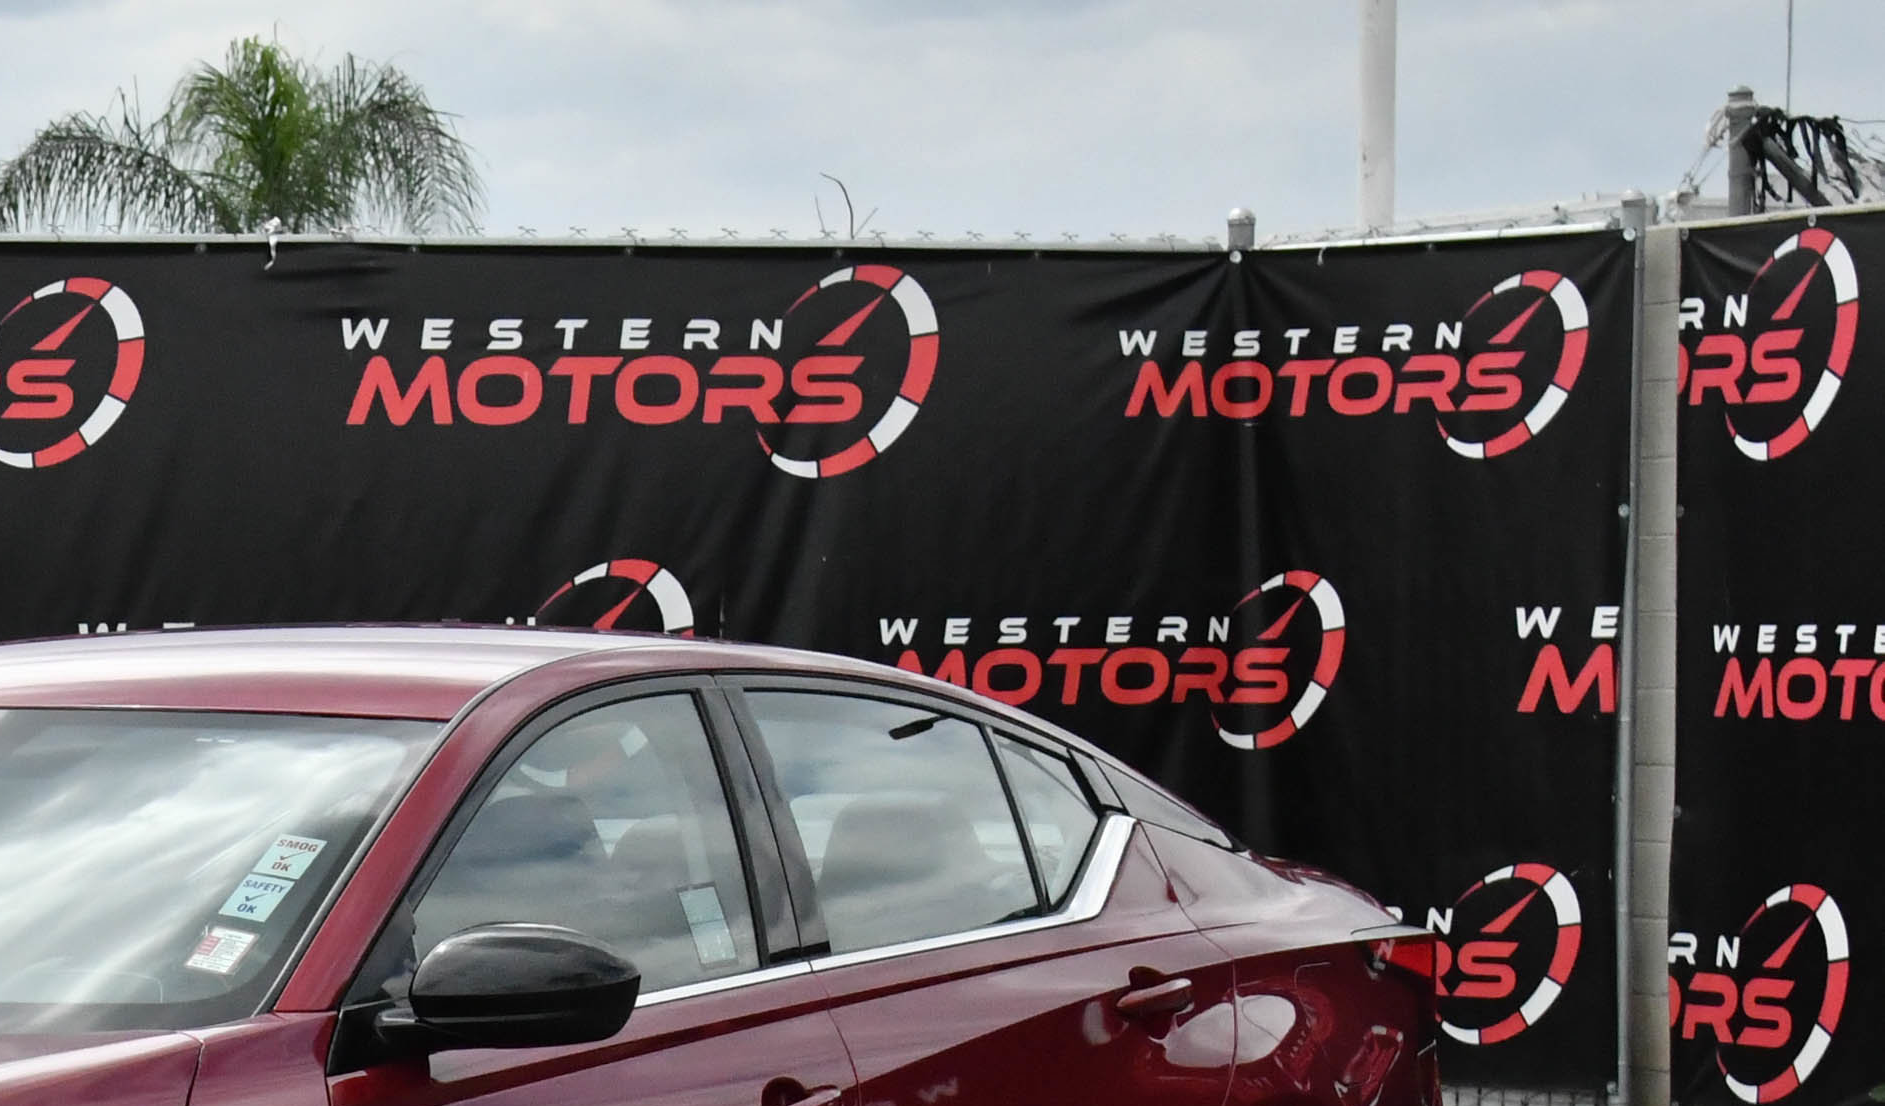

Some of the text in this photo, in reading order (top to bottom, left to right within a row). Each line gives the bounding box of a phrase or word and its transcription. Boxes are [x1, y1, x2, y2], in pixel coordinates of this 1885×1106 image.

[342, 318, 783, 351] WESTERN
[1119, 322, 1463, 357] WESTERN
[1678, 328, 1804, 406] RS
[346, 355, 864, 427] MOTORS
[1124, 352, 1526, 419] MOTORS
[880, 617, 1230, 646] WESTERN
[277, 839, 319, 852] SMOG
[272, 861, 290, 872] OK
[243, 879, 286, 893] SAFETY
[236, 903, 257, 914] OK
[1669, 972, 1795, 1049] RS
